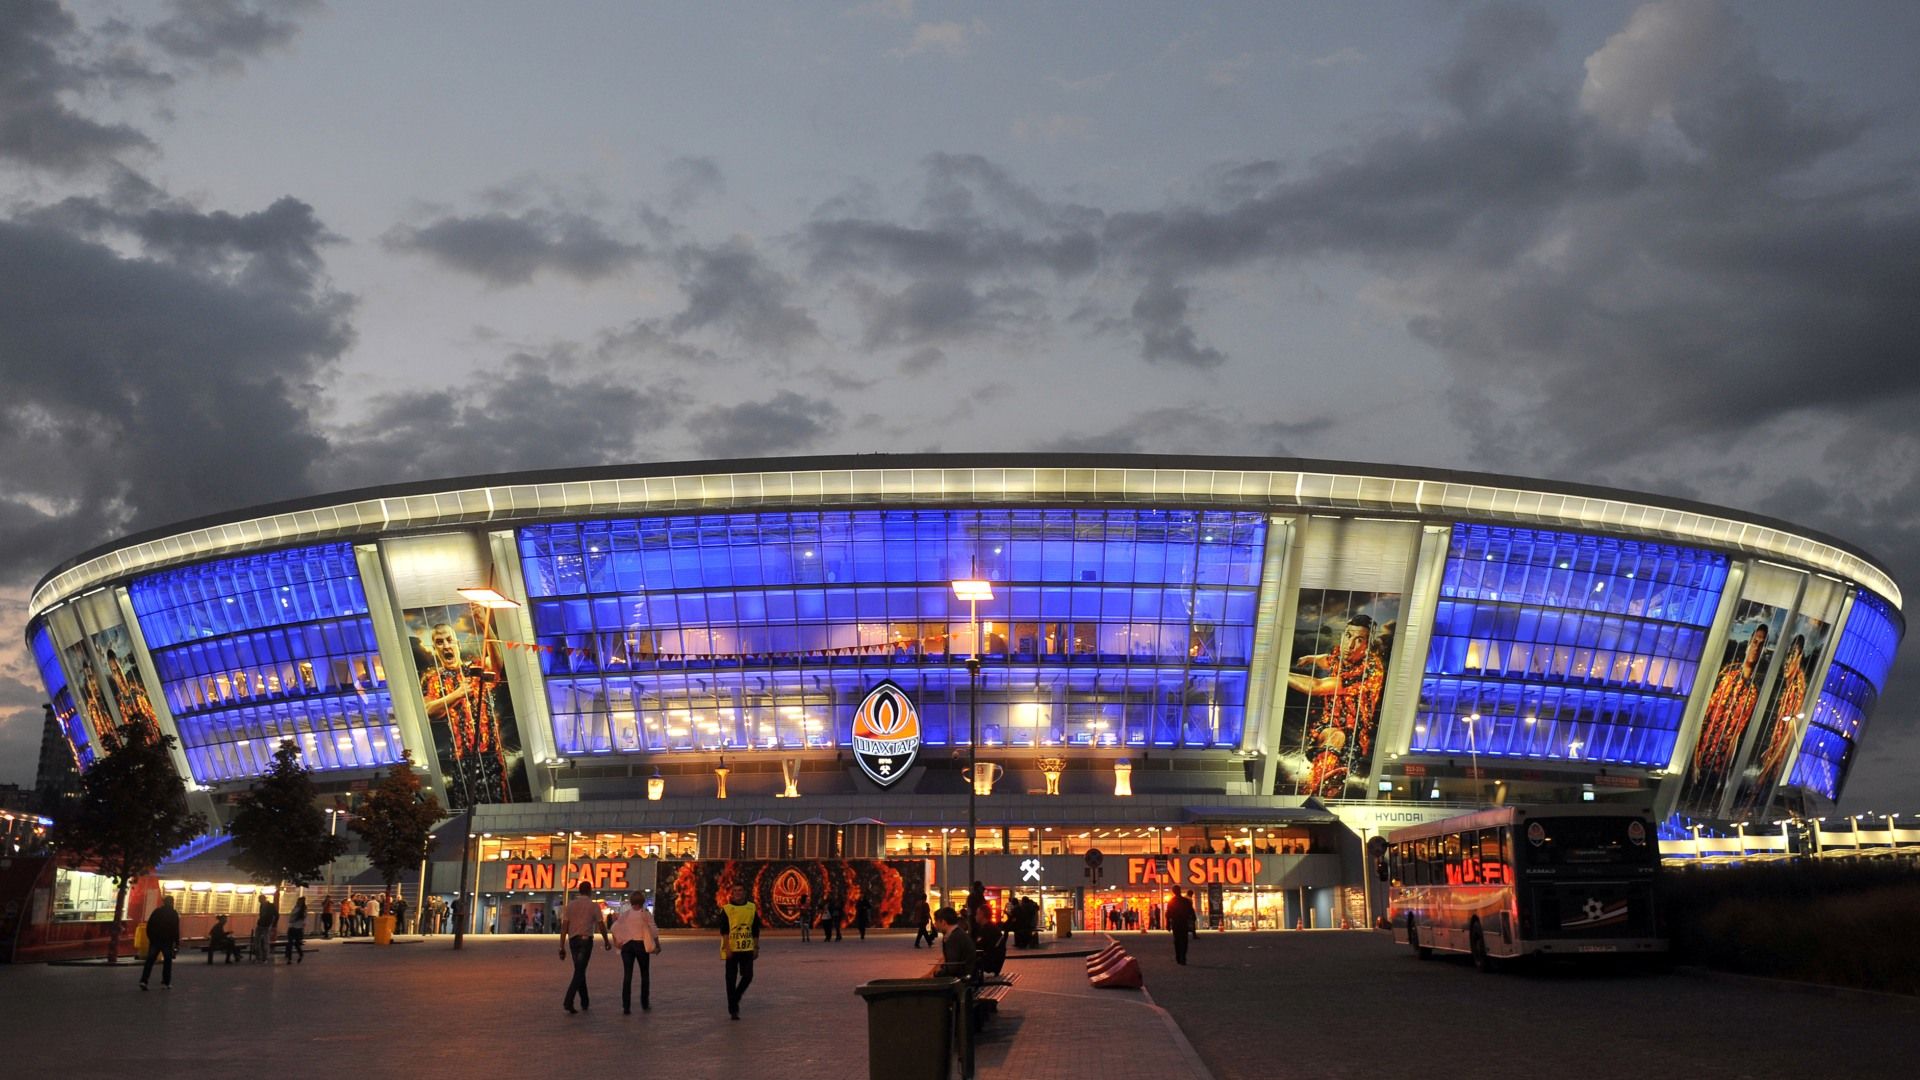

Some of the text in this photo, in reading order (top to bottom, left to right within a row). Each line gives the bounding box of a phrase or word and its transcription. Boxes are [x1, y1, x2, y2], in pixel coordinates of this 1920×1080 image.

[855, 737, 918, 754] ШАХТАР
[1375, 812, 1423, 822] HYUNDAI
[505, 861, 629, 890] FAN CAFE
[1128, 856, 1263, 885] FAN SHOP
[736, 939, 751, 949] 187
